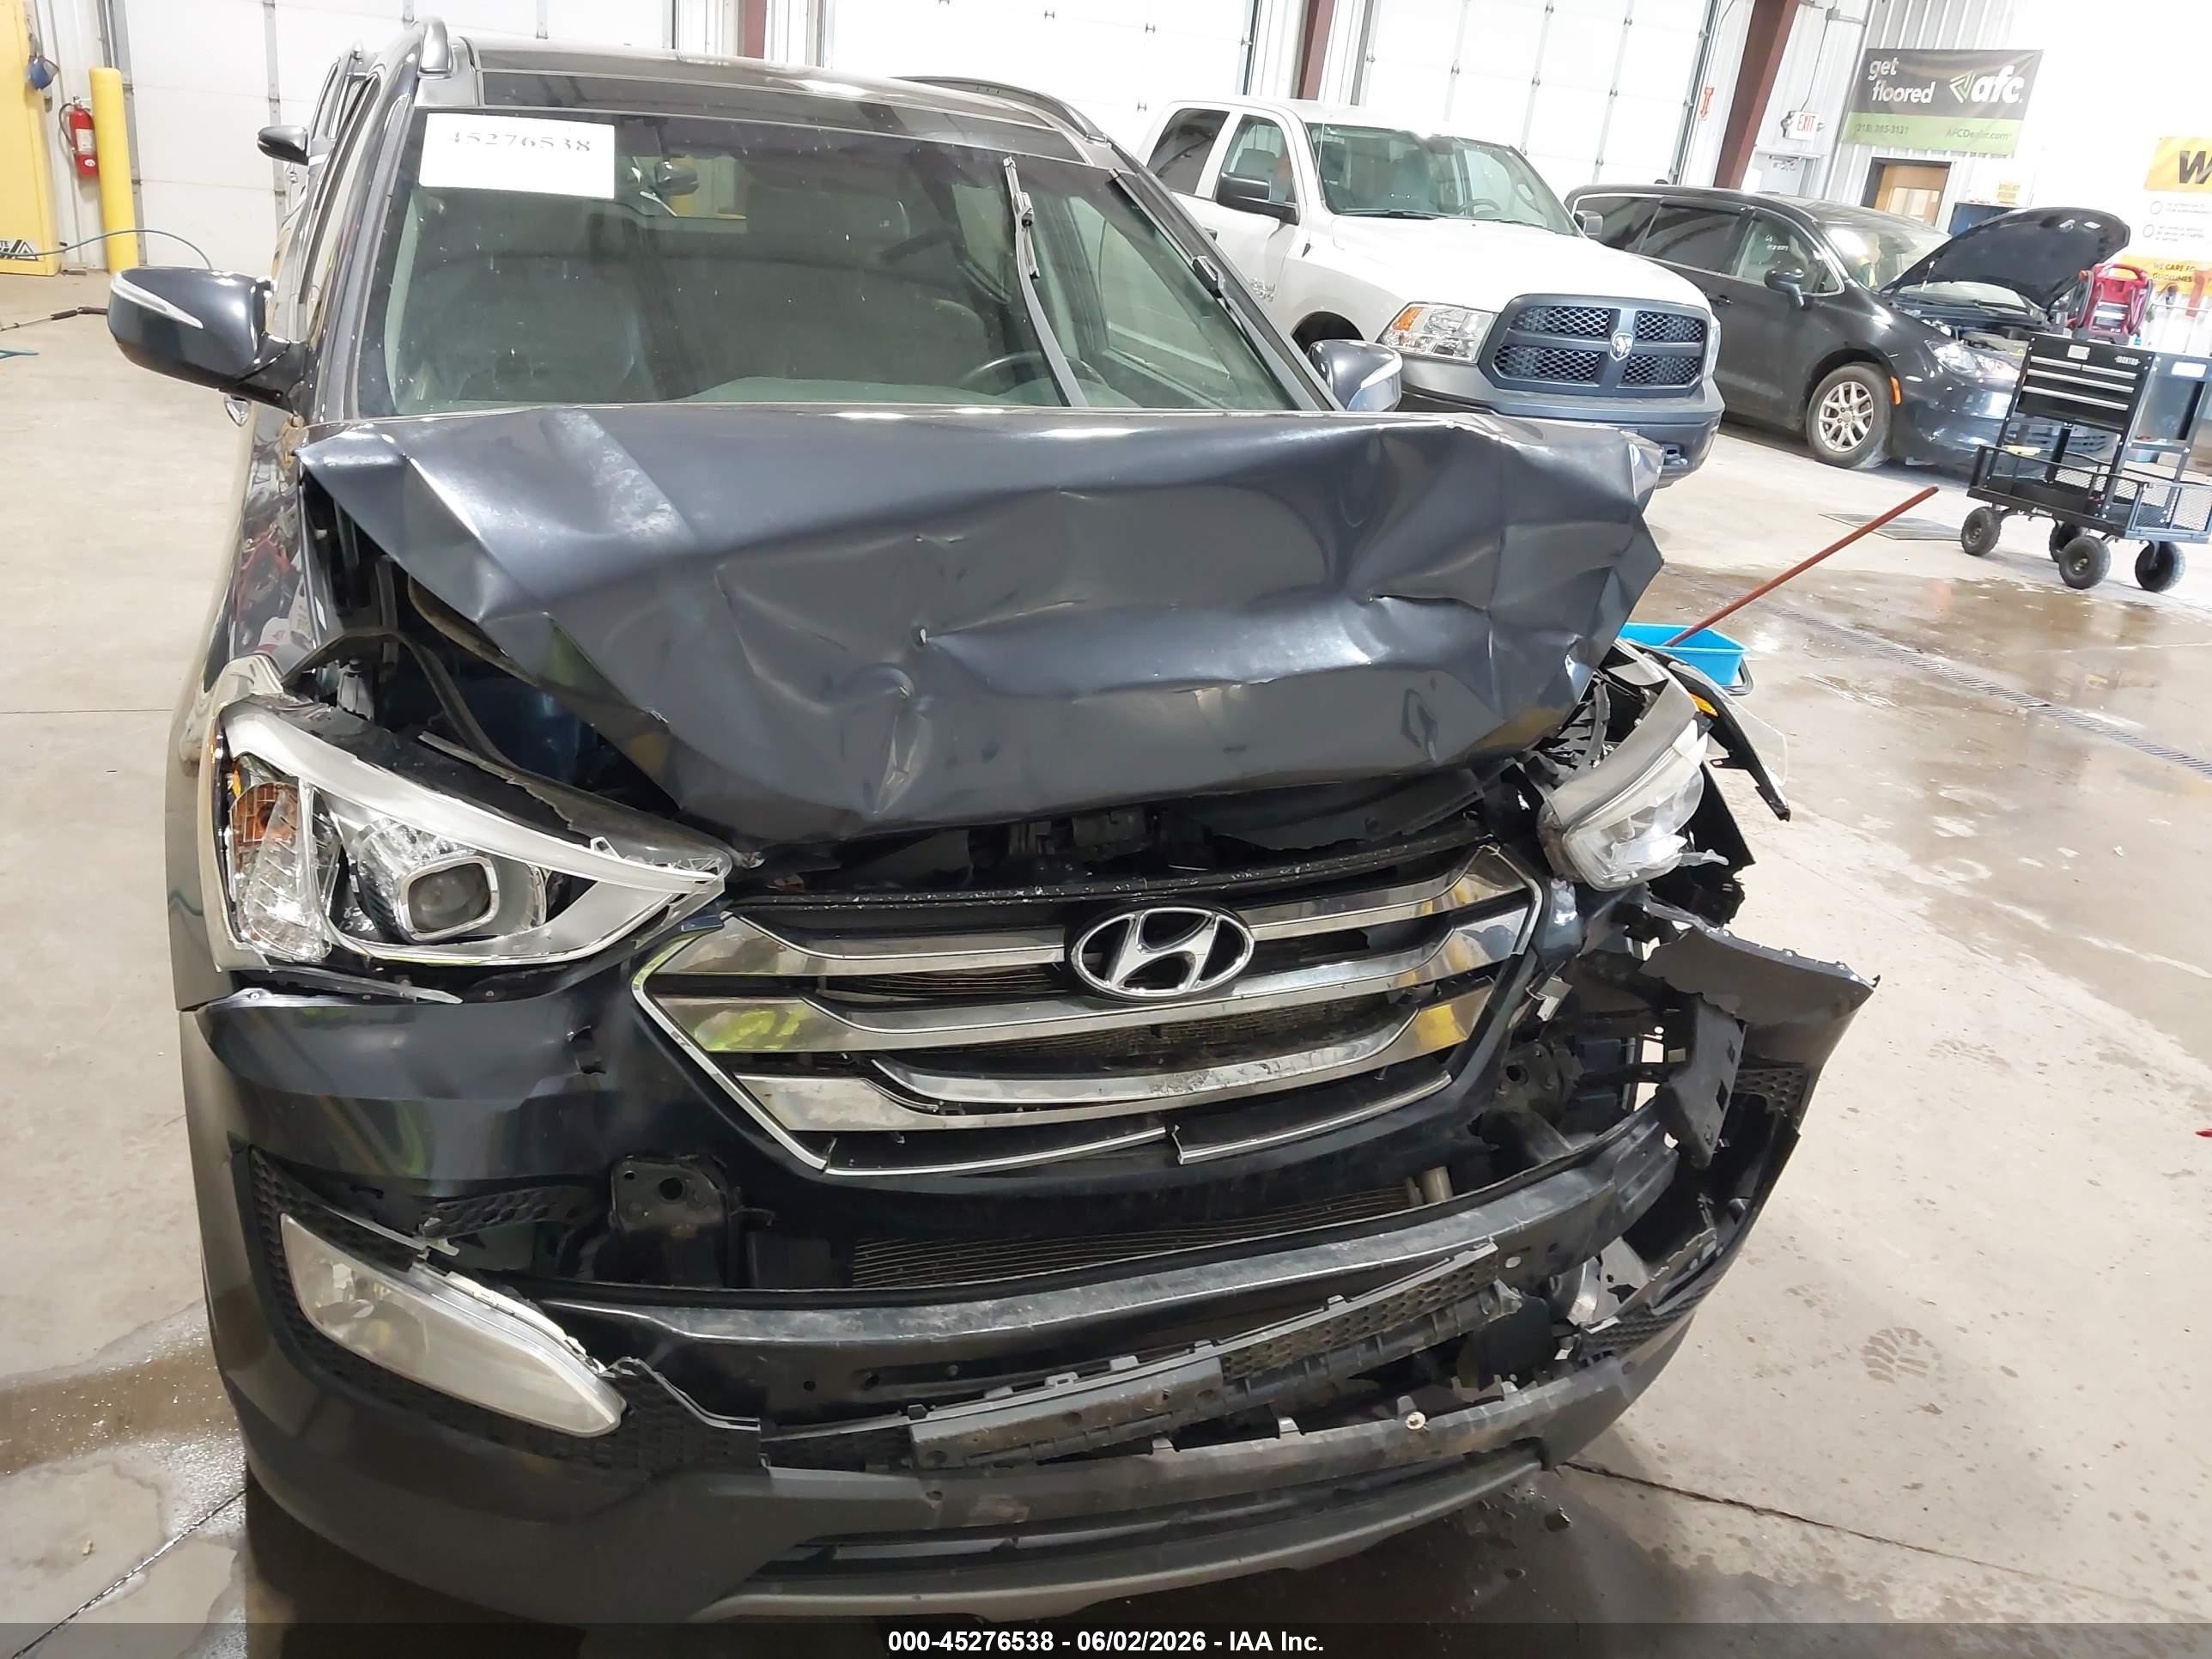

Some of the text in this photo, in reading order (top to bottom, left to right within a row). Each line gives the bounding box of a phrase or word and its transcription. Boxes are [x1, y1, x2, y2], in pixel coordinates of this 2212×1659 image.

[1868, 57, 1899, 81] get
[1872, 79, 1936, 104] floored
[1796, 113, 1816, 132] EXIT
